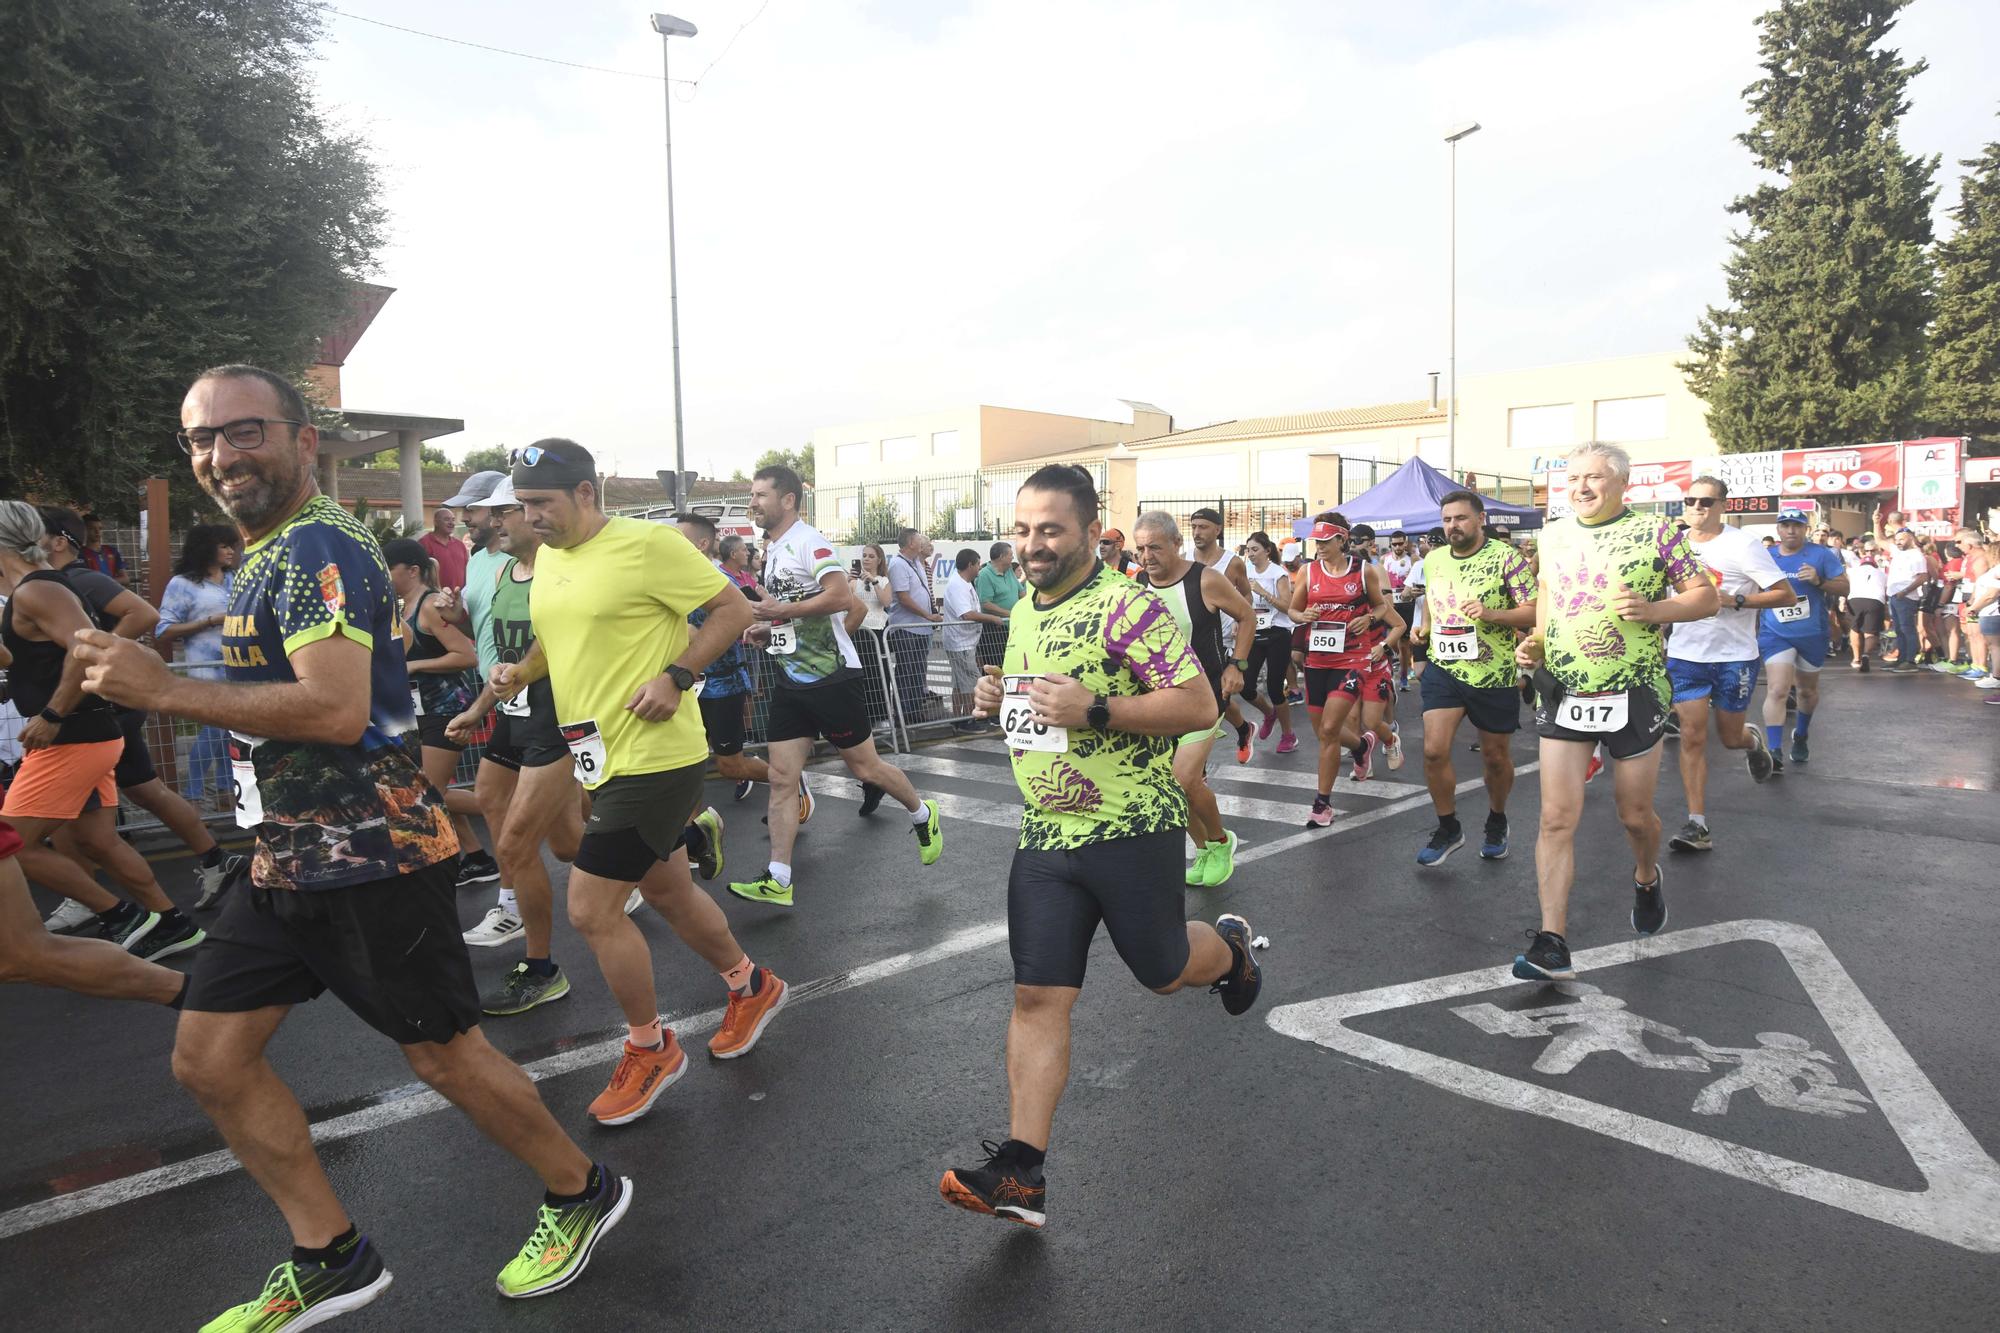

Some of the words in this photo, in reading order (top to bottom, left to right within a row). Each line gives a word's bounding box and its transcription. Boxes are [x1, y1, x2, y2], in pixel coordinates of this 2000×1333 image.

[1720, 465, 1775, 477] NON
[1780, 607, 1802, 618] 133
[1313, 636, 1336, 647] 650
[1438, 641, 1468, 654] 016
[1570, 705, 1613, 722] 017
